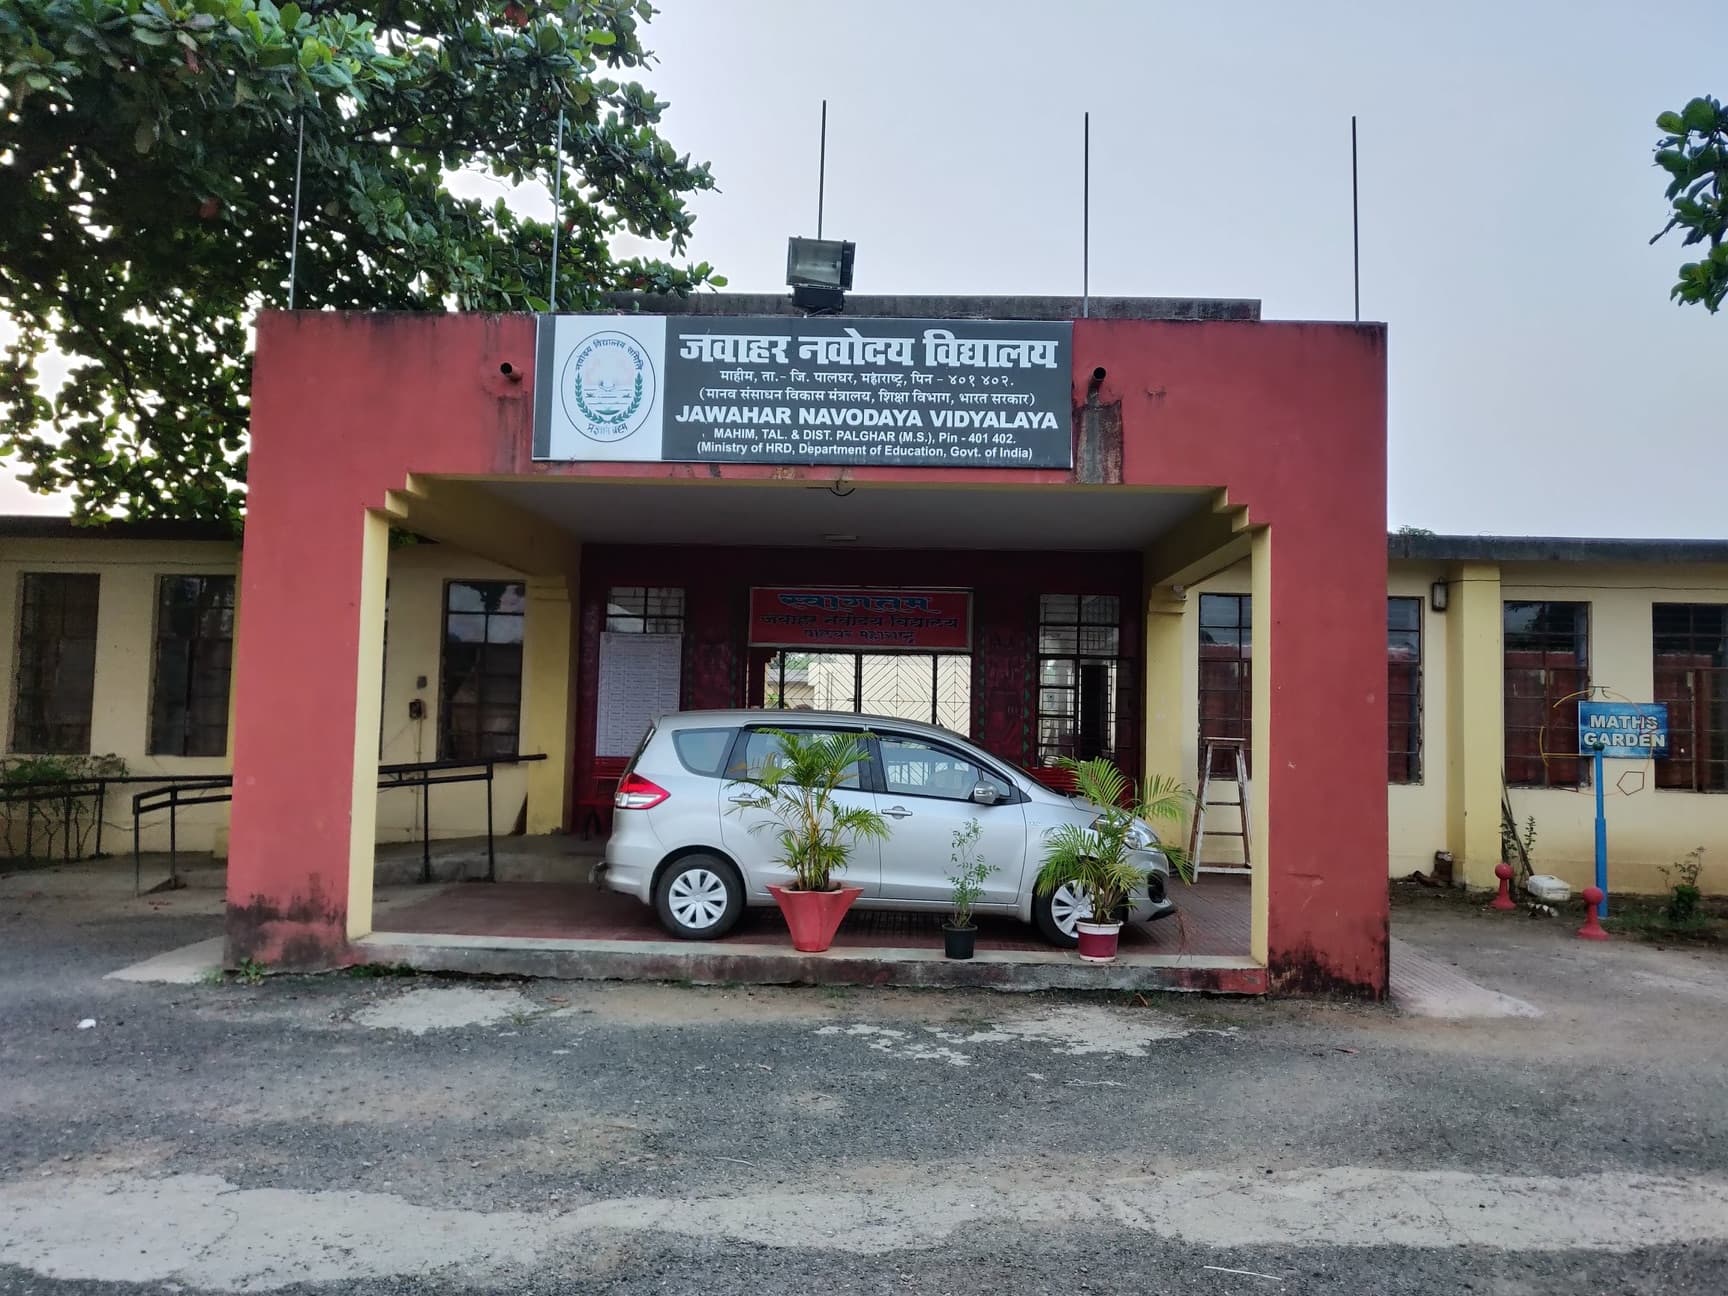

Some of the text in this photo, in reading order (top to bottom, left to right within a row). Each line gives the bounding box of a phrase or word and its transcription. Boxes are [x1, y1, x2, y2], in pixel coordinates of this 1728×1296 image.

[679, 328, 1059, 368] जवाहर नवोदय विद्यालय
[719, 368, 758, 384] माहीम,
[813, 373, 857, 385] पालघर,
[910, 370, 933, 385] पिन
[948, 375, 976, 387] ४०१
[699, 386, 737, 401] (मानव
[786, 387, 825, 402] विकास
[827, 388, 876, 403] मंत्रालय,
[878, 388, 909, 403] शिक्षा
[912, 389, 954, 406] विभाग,
[959, 392, 988, 404] भारत
[991, 393, 1035, 406] सरकार)
[675, 405, 1059, 430] JAWAHAR NAVODAYA VIDYALAYA
[714, 428, 758, 440] MAHIM,
[762, 429, 787, 440] TAL.
[791, 430, 800, 440] &
[803, 430, 832, 441] DIST.
[836, 430, 896, 442] PALGHAR
[898, 432, 935, 445] (M.S.),
[938, 433, 958, 443] Pin
[969, 433, 988, 444] 401
[992, 433, 1016, 444] 402.
[697, 441, 1033, 460] (Ministry of HRD, Department of Education, Govt. of India)
[1590, 714, 1658, 730] MATHS
[1583, 732, 1665, 748] GARDEN
